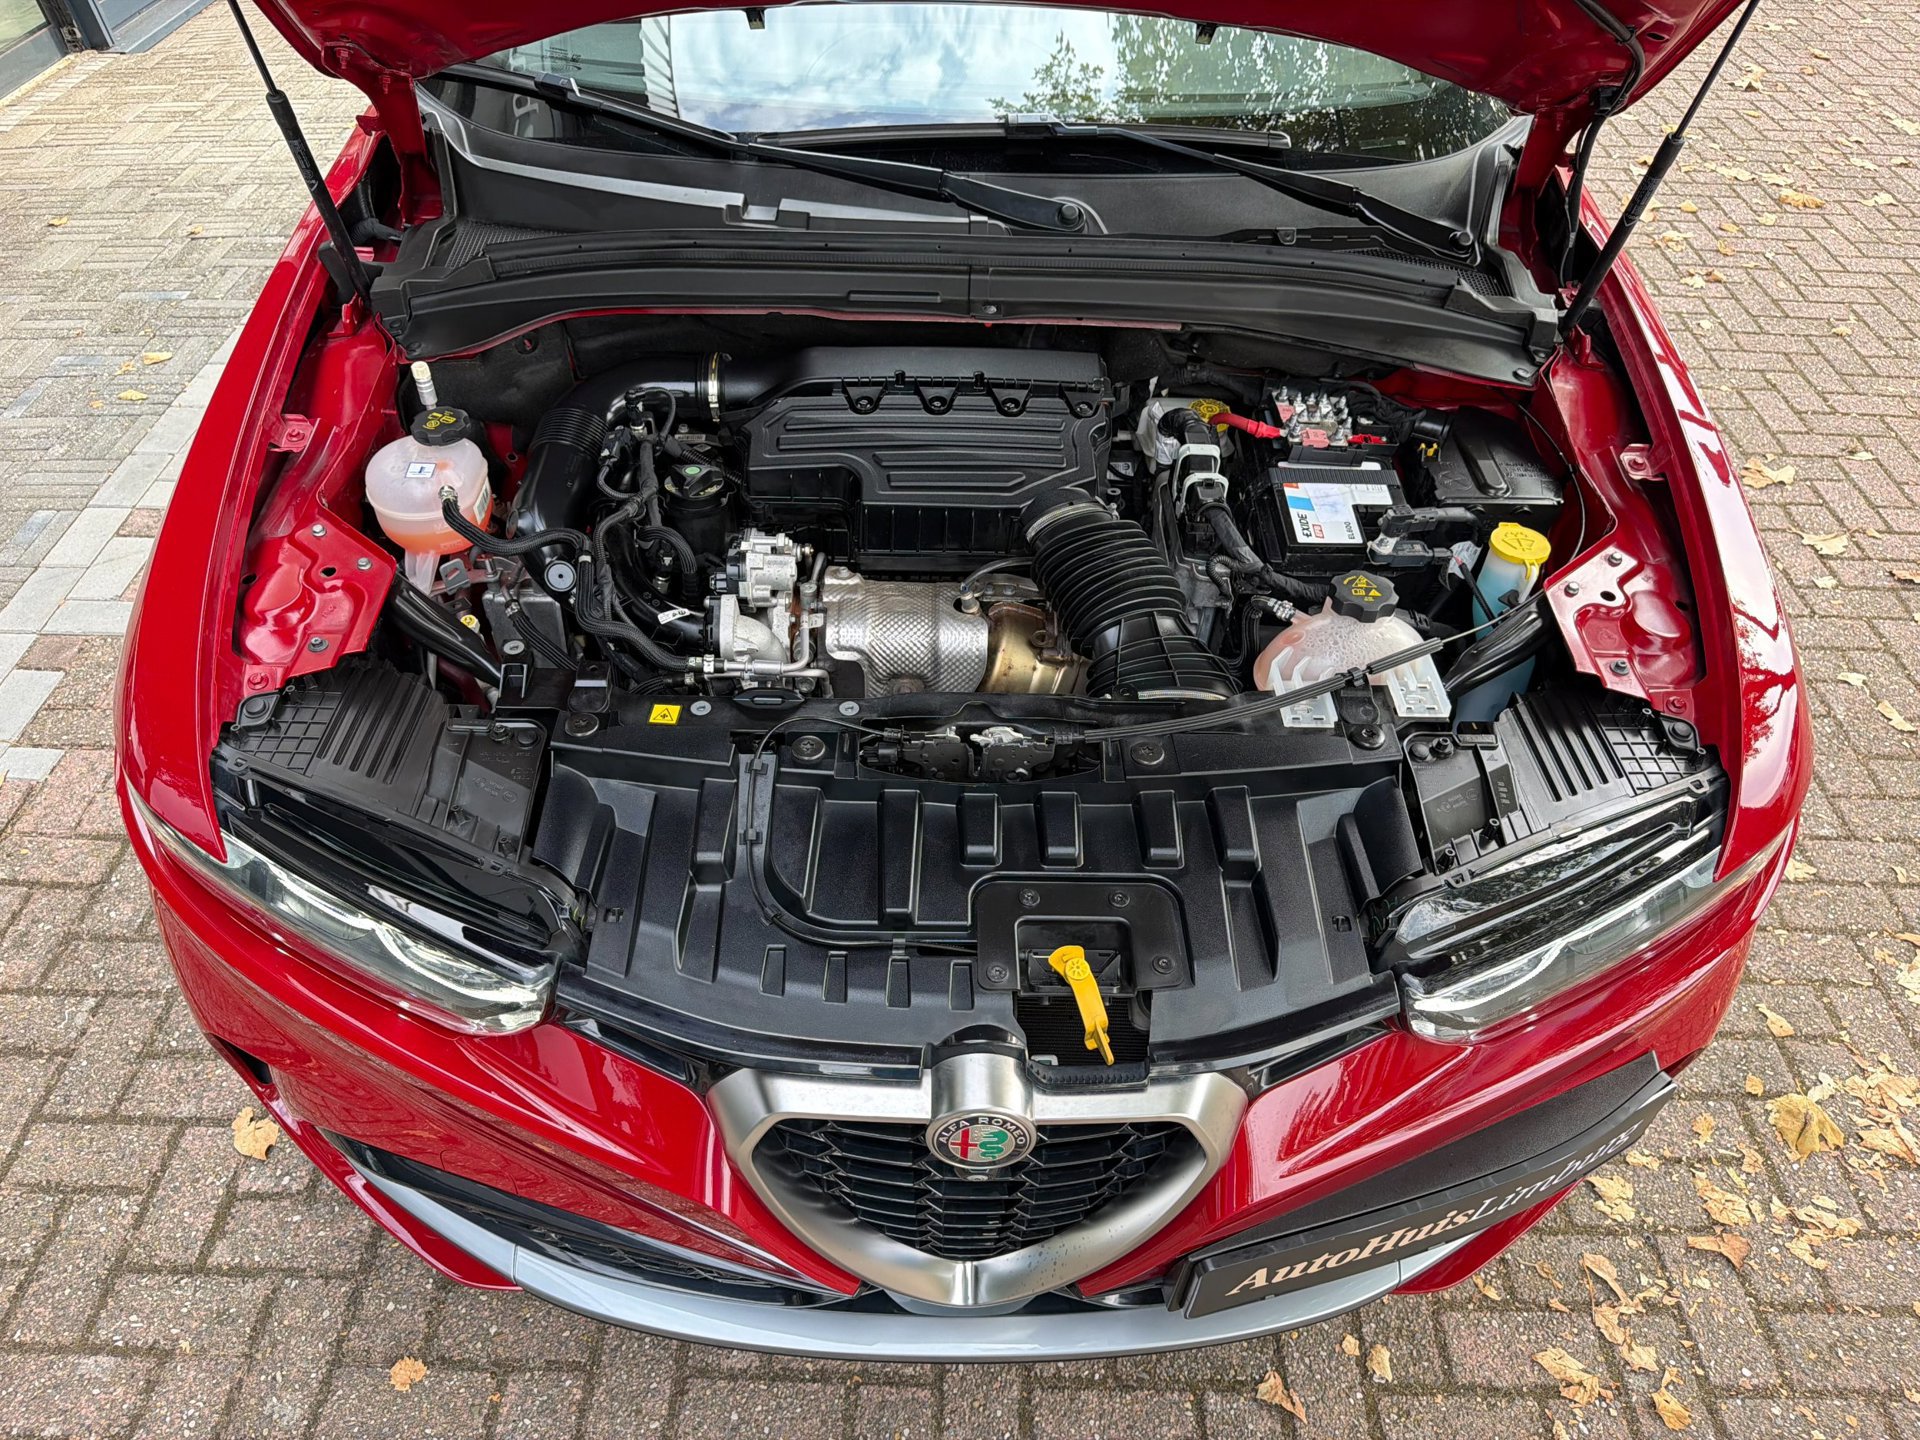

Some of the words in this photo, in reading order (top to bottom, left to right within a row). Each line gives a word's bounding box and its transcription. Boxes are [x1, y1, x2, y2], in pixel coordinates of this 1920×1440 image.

[1297, 513, 1312, 538] EXIDE
[938, 1120, 971, 1144] ALFA
[978, 1117, 1026, 1145] ROMEO
